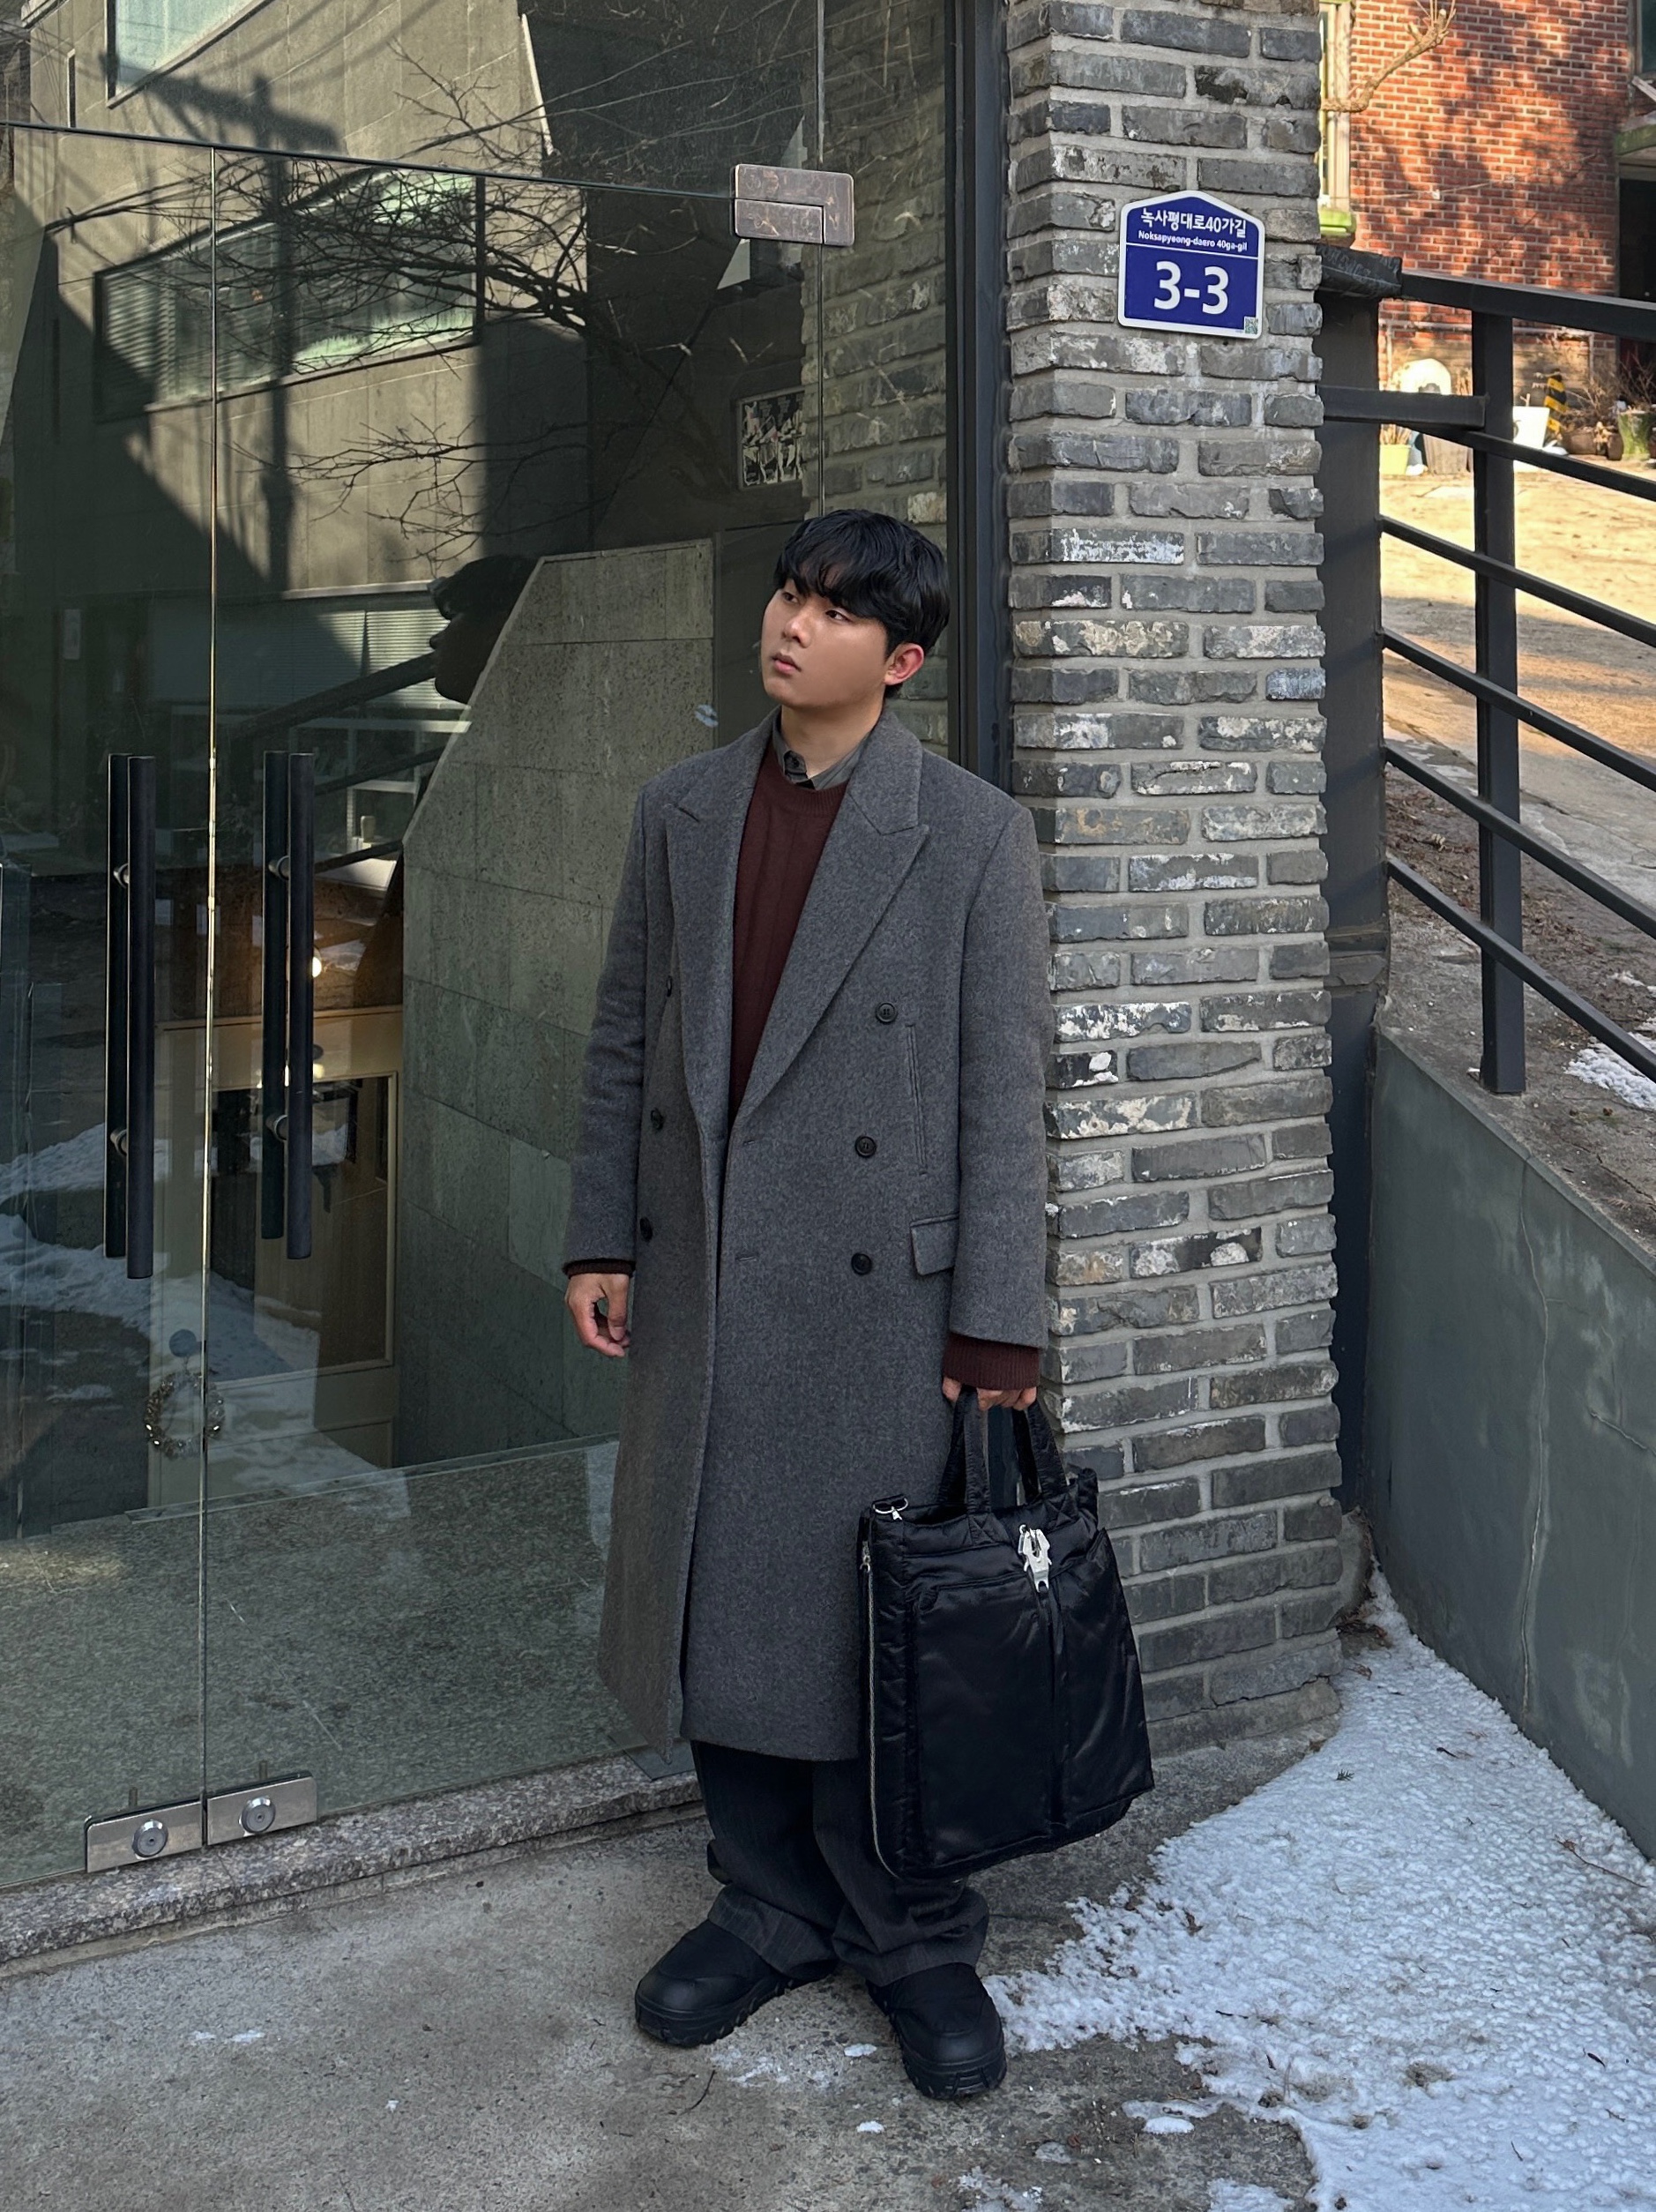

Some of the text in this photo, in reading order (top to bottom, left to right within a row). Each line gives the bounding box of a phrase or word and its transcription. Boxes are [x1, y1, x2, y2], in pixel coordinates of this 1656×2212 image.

[1141, 207, 1246, 238] 녹사평대로40가길
[1138, 230, 1248, 252] Noksapyeong-daero 40ga-gil
[1154, 261, 1228, 314] 3-3
